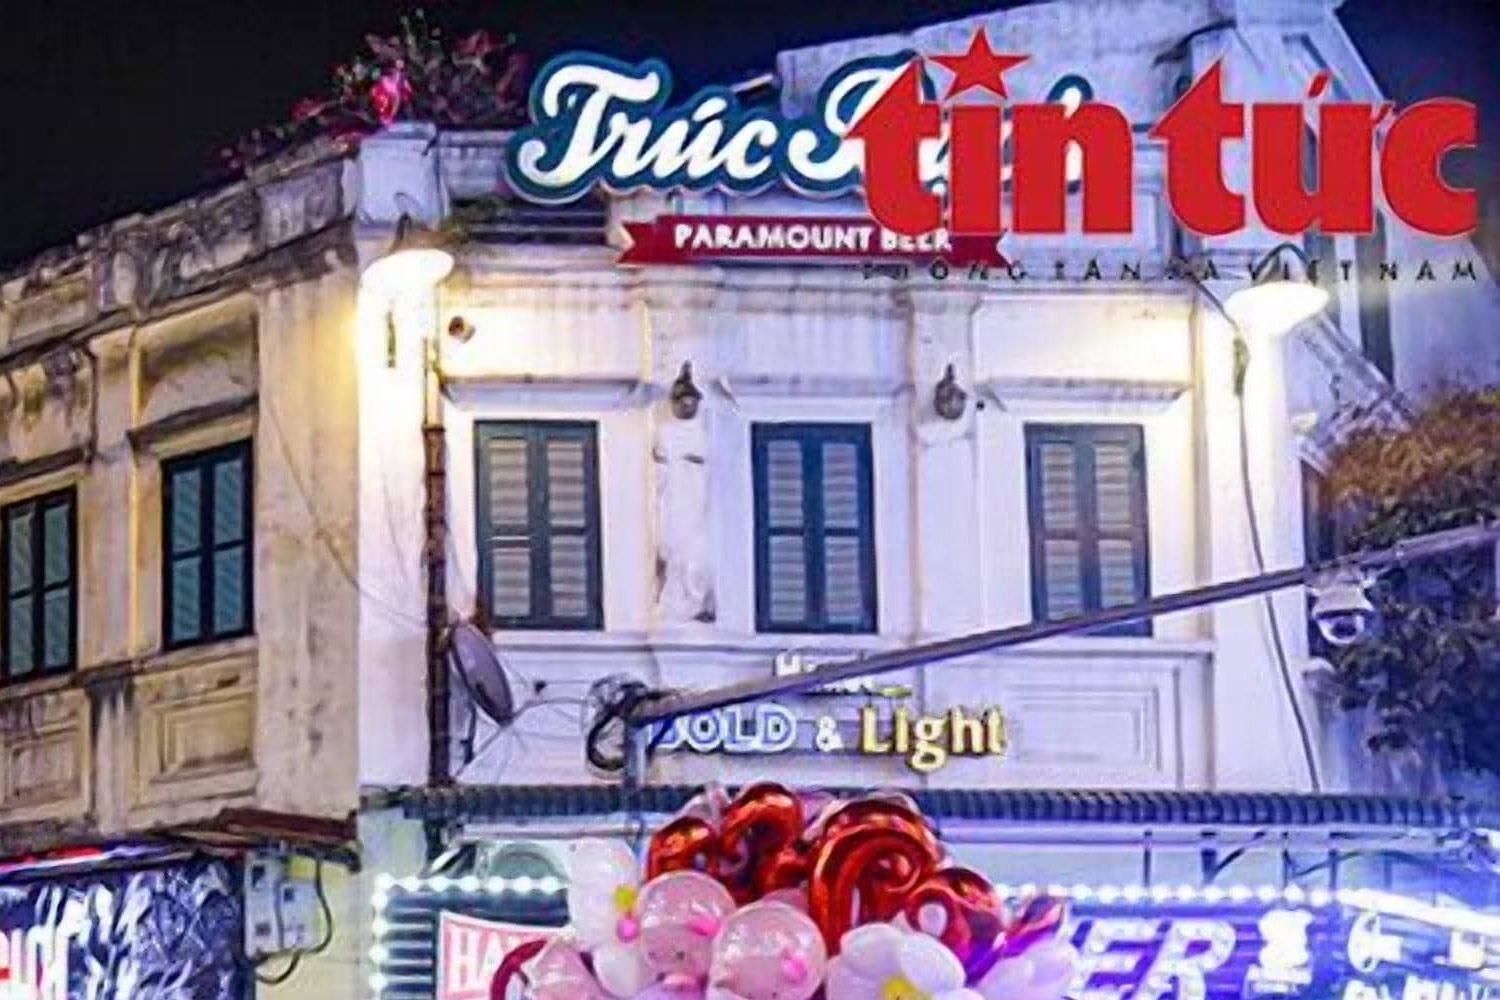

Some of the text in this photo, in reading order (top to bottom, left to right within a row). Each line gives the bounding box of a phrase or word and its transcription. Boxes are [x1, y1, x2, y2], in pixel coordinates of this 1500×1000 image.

[518, 64, 778, 187] Trúc
[673, 222, 873, 250] PARAMOUNT
[816, 716, 843, 752] &
